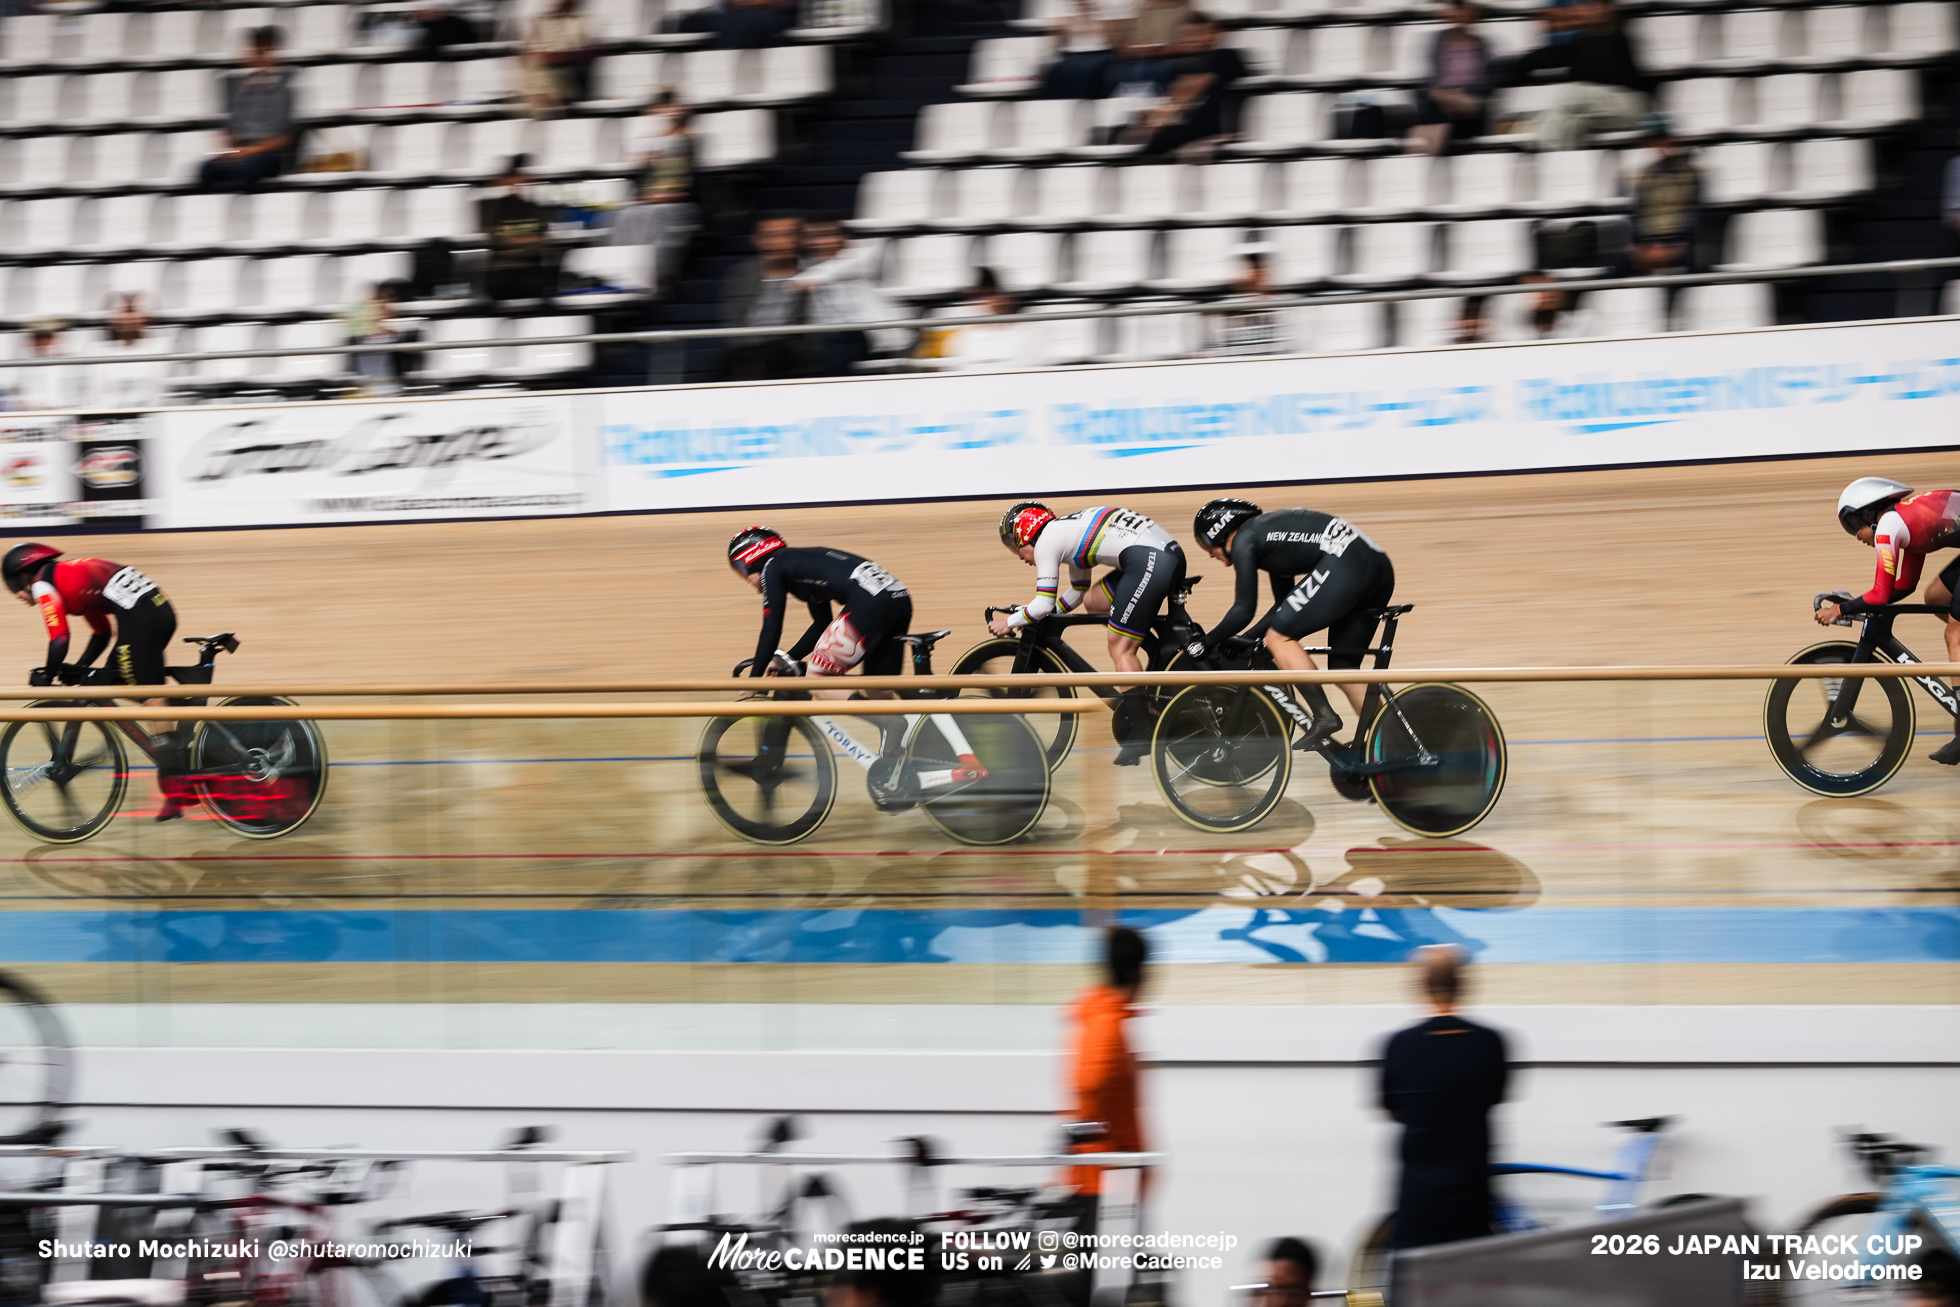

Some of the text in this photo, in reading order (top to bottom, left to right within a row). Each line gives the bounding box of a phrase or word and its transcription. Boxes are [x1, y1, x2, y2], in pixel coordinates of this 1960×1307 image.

[1114, 512, 1144, 530] 141
[1266, 532, 1324, 543] NEW ZEALAN
[1286, 569, 1331, 612] NZL
[826, 721, 866, 759] TORAY
